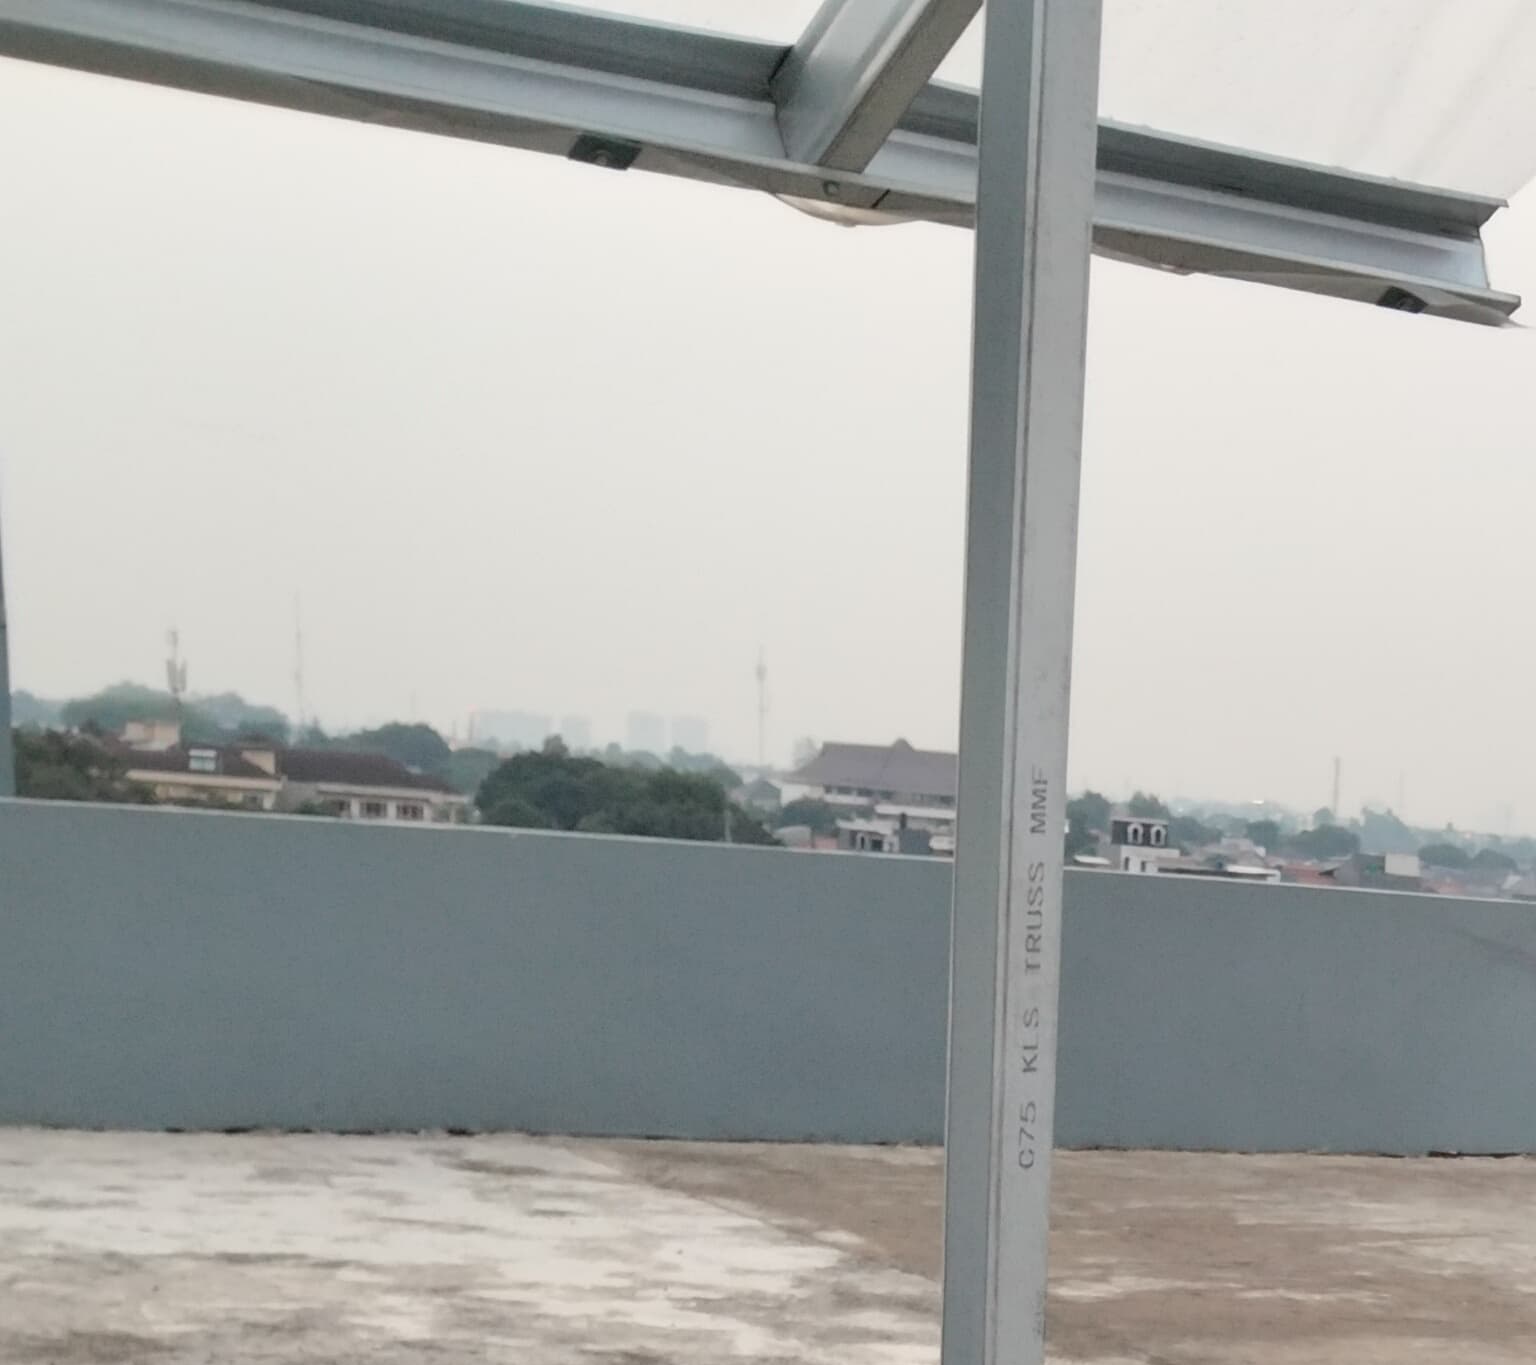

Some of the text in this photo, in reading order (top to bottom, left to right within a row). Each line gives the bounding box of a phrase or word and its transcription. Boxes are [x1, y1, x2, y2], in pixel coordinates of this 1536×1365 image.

[1024, 862, 1045, 976] TRUSS
[1022, 1007, 1039, 1073] KLS
[1018, 1100, 1037, 1169] C75
